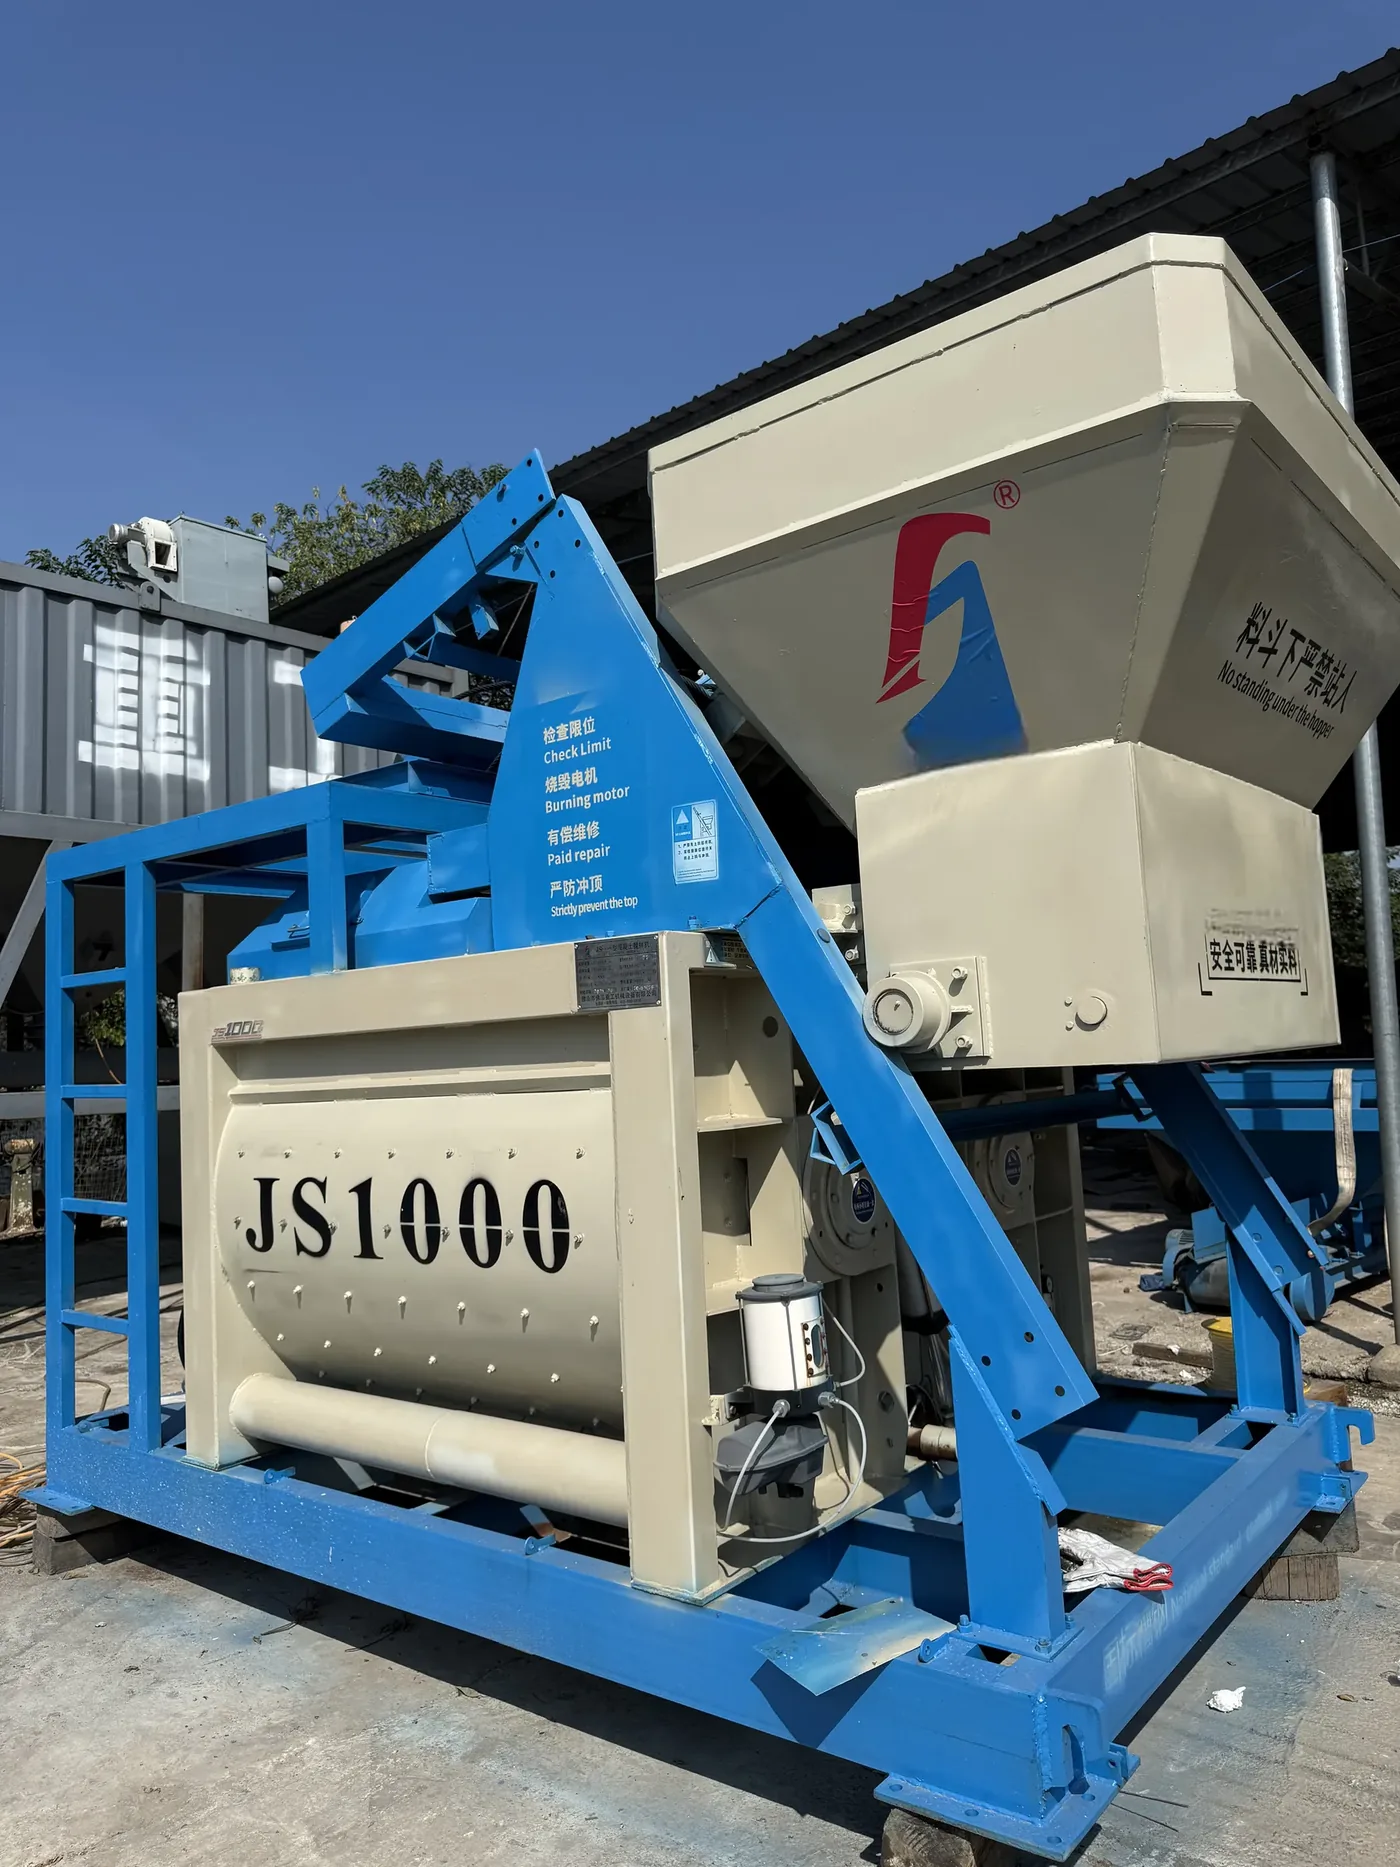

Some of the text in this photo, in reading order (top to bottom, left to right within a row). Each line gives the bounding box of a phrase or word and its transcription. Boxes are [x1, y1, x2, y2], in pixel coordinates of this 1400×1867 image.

[1236, 602, 1357, 714] 料斗下严禁站人
[1217, 660, 1335, 739] No standing under the hopper
[543, 716, 595, 745] 检查限位
[544, 737, 611, 764] Check Limit
[545, 766, 598, 794] 烧毁电机
[545, 786, 630, 814] Burning motor
[547, 820, 600, 846] 有偿维修
[547, 843, 610, 866] Paid repair
[550, 874, 603, 899] 严防冲顶
[551, 896, 638, 917] Strictly prevent the top
[245, 1176, 570, 1274] JS1000
